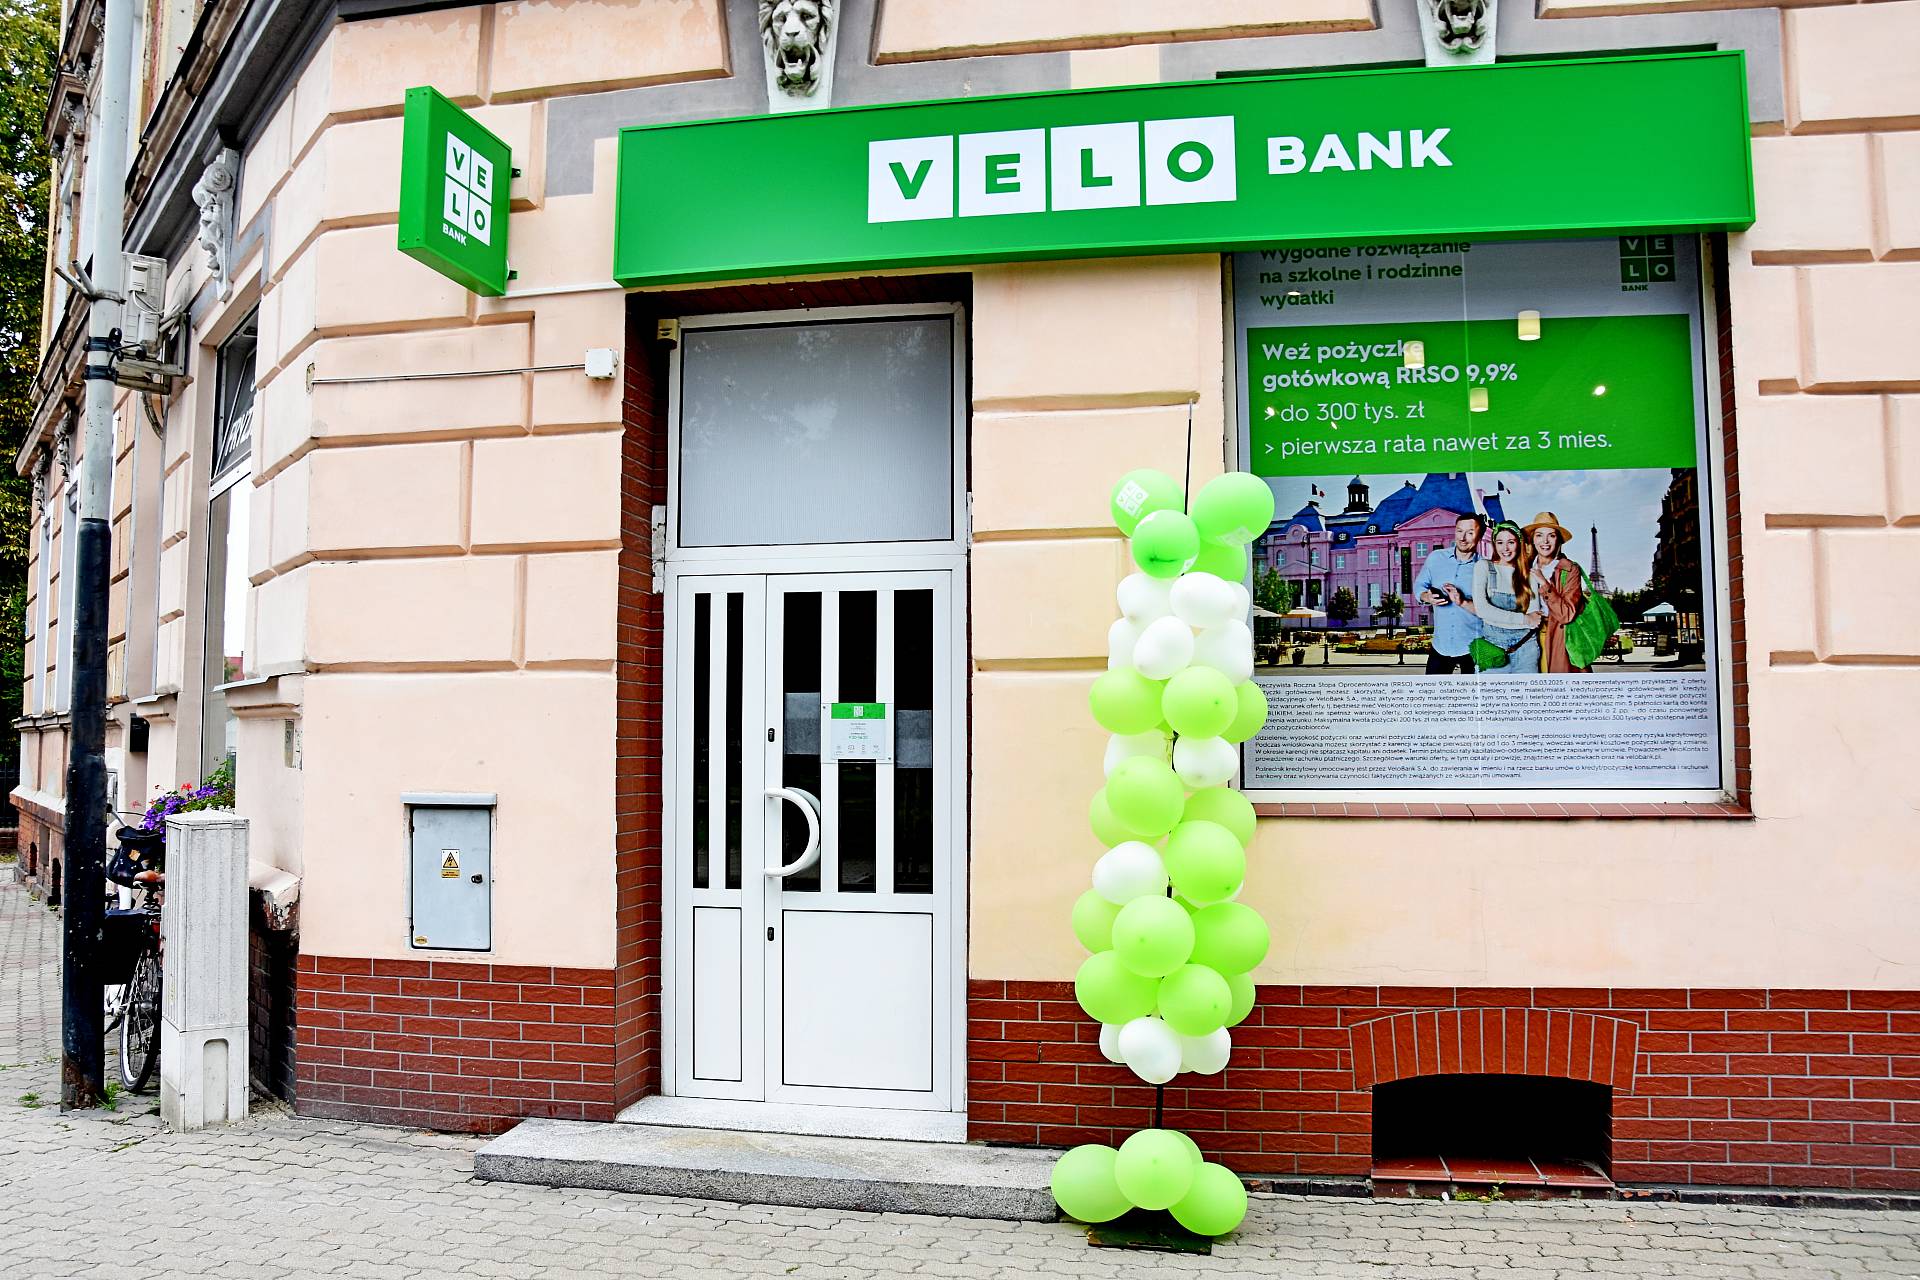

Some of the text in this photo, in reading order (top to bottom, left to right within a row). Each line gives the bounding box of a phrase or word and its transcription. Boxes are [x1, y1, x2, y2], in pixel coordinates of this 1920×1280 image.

[887, 128, 1453, 200] VELO BANK
[442, 223, 467, 246] BANK
[1356, 241, 1471, 259] rozwiązanie
[1259, 262, 1463, 284] na szkolne i rodzinne
[1621, 284, 1649, 292] BANK
[1260, 290, 1334, 310] wydatki
[1262, 342, 1311, 361] Weź
[1262, 363, 1518, 393] gotówkową RRSO 9,9%
[1280, 400, 1425, 424] do 300 tys. zł
[1281, 430, 1612, 459] pierwsza rata nawet za 3 mies.
